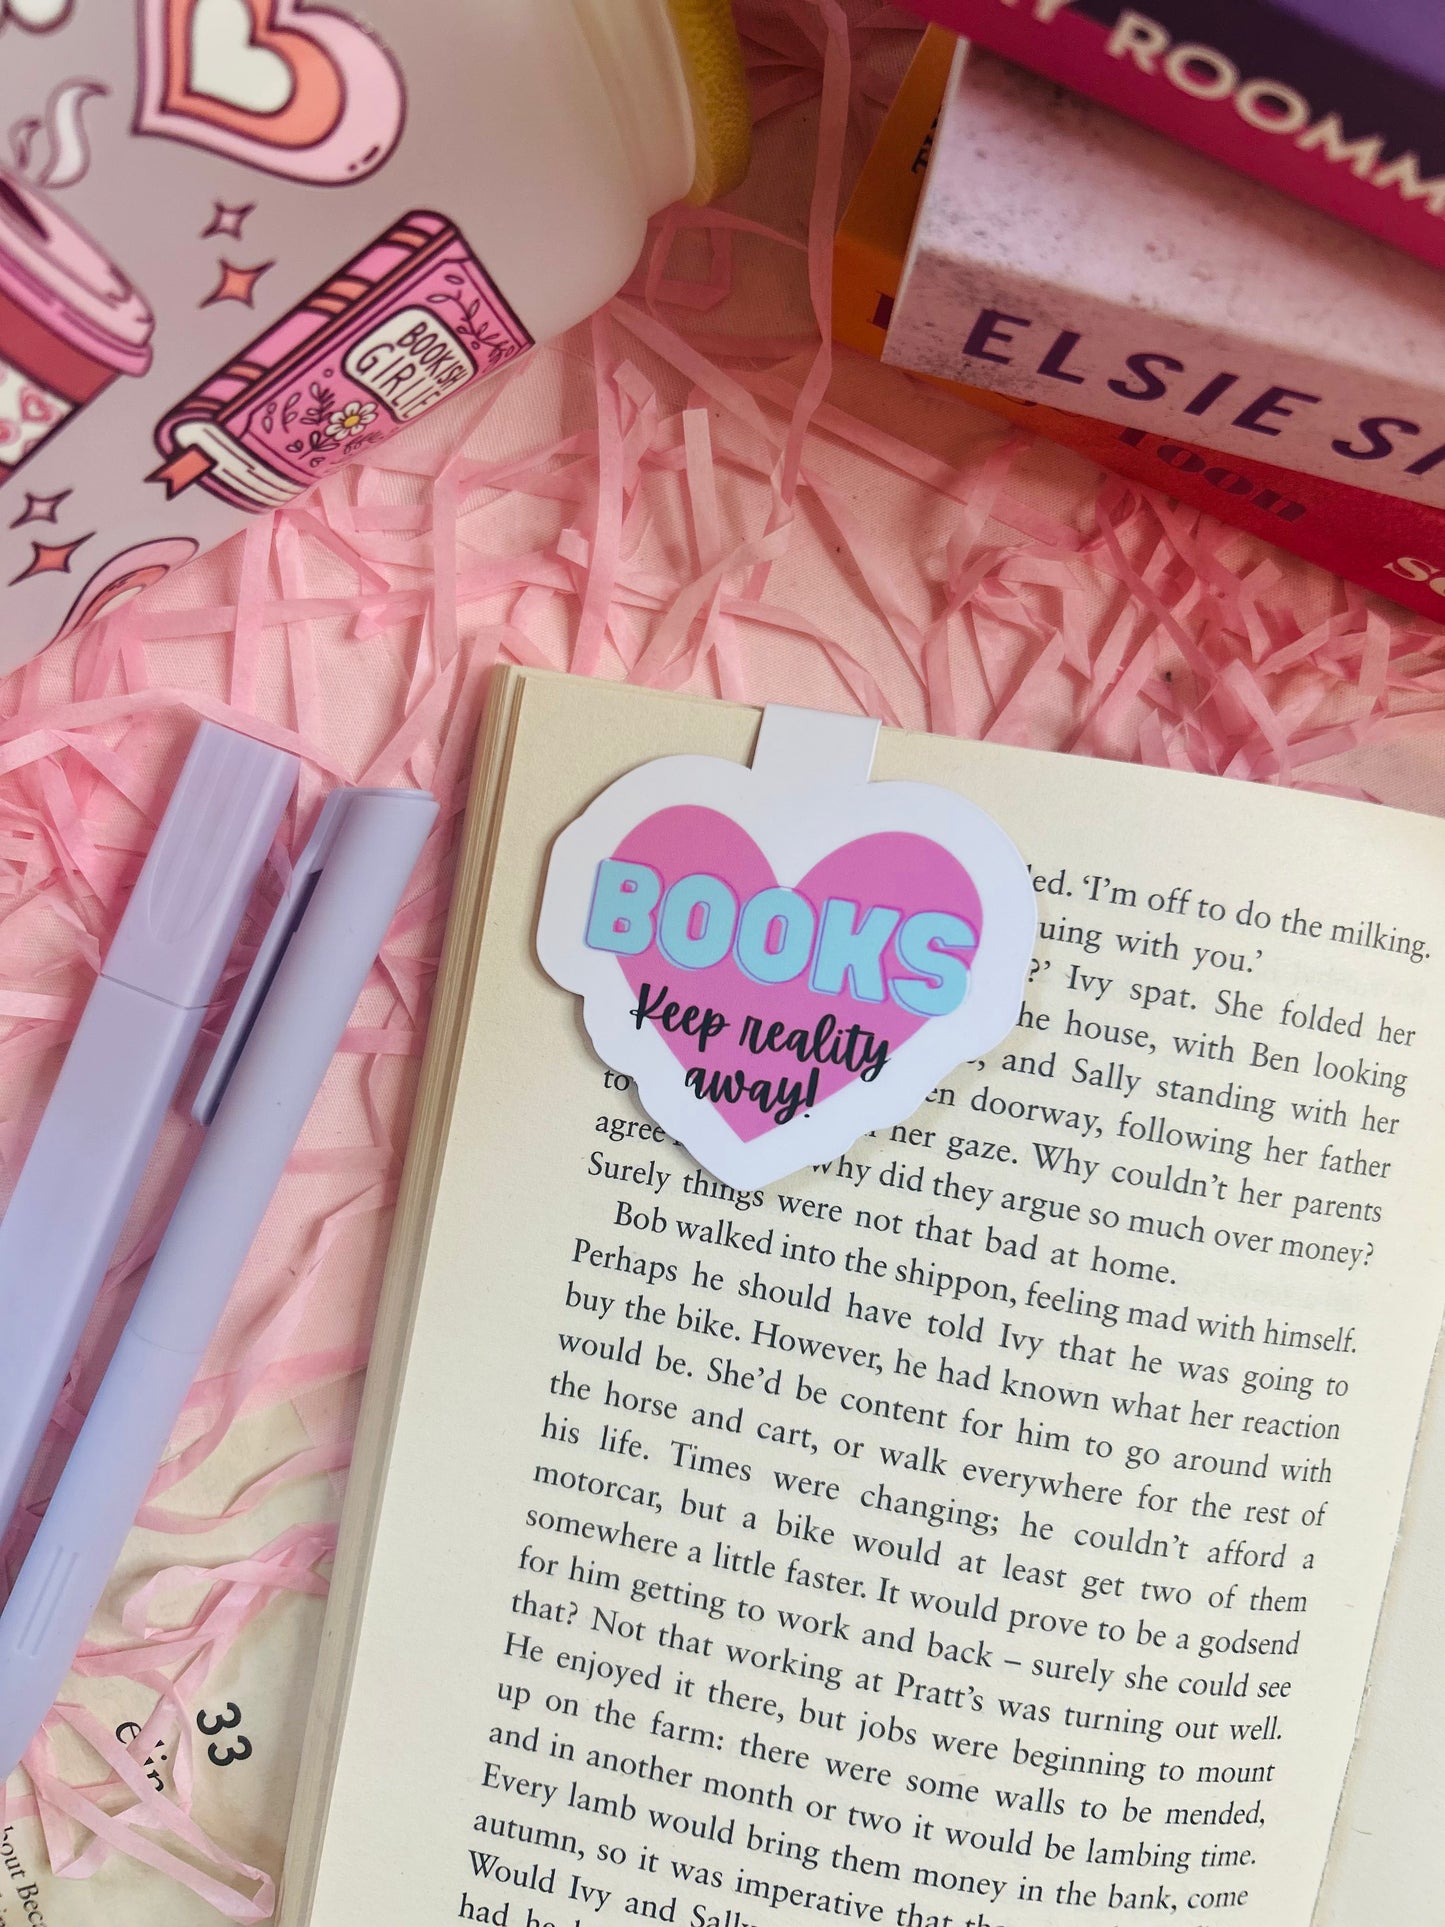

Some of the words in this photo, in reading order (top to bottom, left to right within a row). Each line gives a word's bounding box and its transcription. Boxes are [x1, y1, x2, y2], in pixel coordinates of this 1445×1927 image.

[356, 342, 442, 419] GIRLIE
[397, 321, 469, 391] BOOKISH
[962, 308, 1322, 436] ELSIE
[583, 856, 981, 1018] BOOKS
[1083, 875, 1136, 907] ‘I’m
[1148, 887, 1192, 915] off
[1198, 899, 1225, 921] to
[1236, 900, 1271, 928] do
[1281, 908, 1322, 937] the
[1329, 921, 1430, 963] milking.
[1116, 931, 1178, 960] with
[1192, 948, 1262, 973] you.’
[629, 982, 730, 1053] Keep
[738, 1014, 891, 1082] reality
[1064, 1009, 1156, 1054] house,
[1173, 1033, 1234, 1063] with
[1249, 1042, 1299, 1073] Ben
[1313, 1051, 1408, 1097] looking
[1066, 964, 1113, 1001] Ivy
[1130, 984, 1196, 1010] spat.
[1215, 990, 1263, 1020] She
[1279, 1000, 1363, 1037] folded
[1377, 1016, 1416, 1046] her
[684, 1066, 820, 1126] away!
[971, 1086, 1102, 1138] doorway,
[1116, 1111, 1253, 1164] following
[1264, 1135, 1308, 1166] her
[1319, 1144, 1391, 1178] father
[1002, 1052, 1056, 1078] and
[1072, 1058, 1141, 1098] Sally
[1156, 1080, 1276, 1122] standing
[1291, 1099, 1346, 1127] with
[1360, 1105, 1399, 1134] her
[588, 1151, 672, 1195] Surely
[778, 1195, 843, 1223] were
[854, 1210, 903, 1234] not
[915, 1214, 972, 1248] that
[985, 1226, 1038, 1260] bad
[1050, 1248, 1079, 1267] at
[1090, 1245, 1175, 1284] home.
[879, 1160, 923, 1193] did
[933, 1171, 994, 1212] they
[1001, 1193, 1080, 1222] argue
[1089, 1208, 1119, 1228] so
[1127, 1215, 1204, 1243] much
[1214, 1230, 1273, 1253] over
[1279, 1239, 1374, 1271] money?
[946, 1136, 1018, 1164] gaze.
[1032, 1142, 1101, 1184] Why
[1111, 1165, 1228, 1200] couldn’t
[1238, 1177, 1282, 1208] her
[1291, 1196, 1382, 1222] parents
[571, 1238, 677, 1285] Perhaps
[691, 1260, 723, 1291] he
[738, 1272, 831, 1312] should
[846, 1292, 911, 1329] have
[928, 1313, 984, 1343] told
[998, 1323, 1044, 1359] Ivy
[1060, 1334, 1116, 1367] that
[1129, 1345, 1162, 1374] he
[1178, 1361, 1229, 1384] was
[1241, 1367, 1314, 1400] going
[1327, 1378, 1348, 1396] to
[613, 1201, 667, 1233] Bob
[676, 1219, 773, 1255] walked
[780, 1233, 835, 1267] into
[845, 1247, 887, 1277] the
[895, 1257, 1016, 1308] shippon,
[1025, 1281, 1120, 1327] feeling
[1126, 1306, 1188, 1332] mad
[1197, 1314, 1254, 1342] with
[1263, 1318, 1356, 1353] himself.
[558, 1334, 642, 1366] would
[656, 1344, 692, 1377] be.
[707, 1357, 782, 1395] She’d
[796, 1374, 827, 1404] be
[841, 1393, 947, 1429] content
[960, 1408, 1003, 1439] for
[1016, 1418, 1069, 1452] him
[1086, 1437, 1112, 1458] to
[1125, 1446, 1160, 1469] go
[1173, 1453, 1269, 1478] around
[1281, 1458, 1331, 1483] with
[541, 1412, 579, 1444] his
[599, 1425, 648, 1460] life.
[671, 1440, 751, 1481] Times
[774, 1471, 839, 1500] were
[861, 1483, 998, 1536] changing;
[1020, 1510, 1053, 1540] he
[1074, 1527, 1189, 1559] couldn’t
[1207, 1539, 1286, 1568] afford
[1303, 1554, 1314, 1569] a
[526, 1510, 678, 1557] somewhere
[687, 1546, 701, 1563] a
[712, 1542, 775, 1578] little
[784, 1558, 866, 1598] faster.
[876, 1577, 900, 1604] It
[910, 1591, 999, 1622] would
[1006, 1609, 1088, 1637] prove
[1099, 1621, 1125, 1642] to
[1136, 1619, 1166, 1647] be
[1176, 1634, 1188, 1649] a
[1198, 1629, 1301, 1658] godsend
[512, 1589, 578, 1625] that?
[590, 1606, 646, 1641] Not
[659, 1623, 713, 1656] that
[726, 1645, 843, 1690] working
[855, 1673, 883, 1692] at
[894, 1672, 983, 1712] Pratt’s
[998, 1699, 1050, 1723] was
[1065, 1707, 1164, 1743] turning
[1175, 1721, 1219, 1739] out
[1230, 1715, 1281, 1740] well.
[196, 1701, 253, 1767] 33
[498, 1683, 530, 1710] up
[546, 1695, 578, 1716] on
[595, 1699, 636, 1729] the
[650, 1710, 723, 1750] farm:
[741, 1732, 809, 1769] there
[825, 1757, 891, 1786] were
[906, 1775, 979, 1802] some
[995, 1787, 1065, 1815] walls
[1081, 1800, 1107, 1820] to
[1122, 1796, 1152, 1823] be
[1165, 1799, 1264, 1829] mended,
[468, 1849, 556, 1894] Would
[568, 1875, 612, 1912] Ivy
[625, 1897, 678, 1923] and
[473, 1814, 585, 1861] autumn,
[597, 1843, 627, 1865] so
[638, 1845, 659, 1873] it
[670, 1860, 723, 1888] was
[735, 1868, 884, 1923] imperative
[481, 1762, 558, 1807] Every
[568, 1781, 636, 1821] lamb
[649, 1809, 735, 1845] would
[747, 1824, 820, 1870] bring
[832, 1844, 900, 1880] them
[912, 1866, 1007, 1903] money
[1017, 1876, 1044, 1904] in
[1056, 1880, 1097, 1908] the
[1108, 1883, 1177, 1915] bank,
[1187, 1891, 1248, 1909] come
[458, 1892, 510, 1927] had
